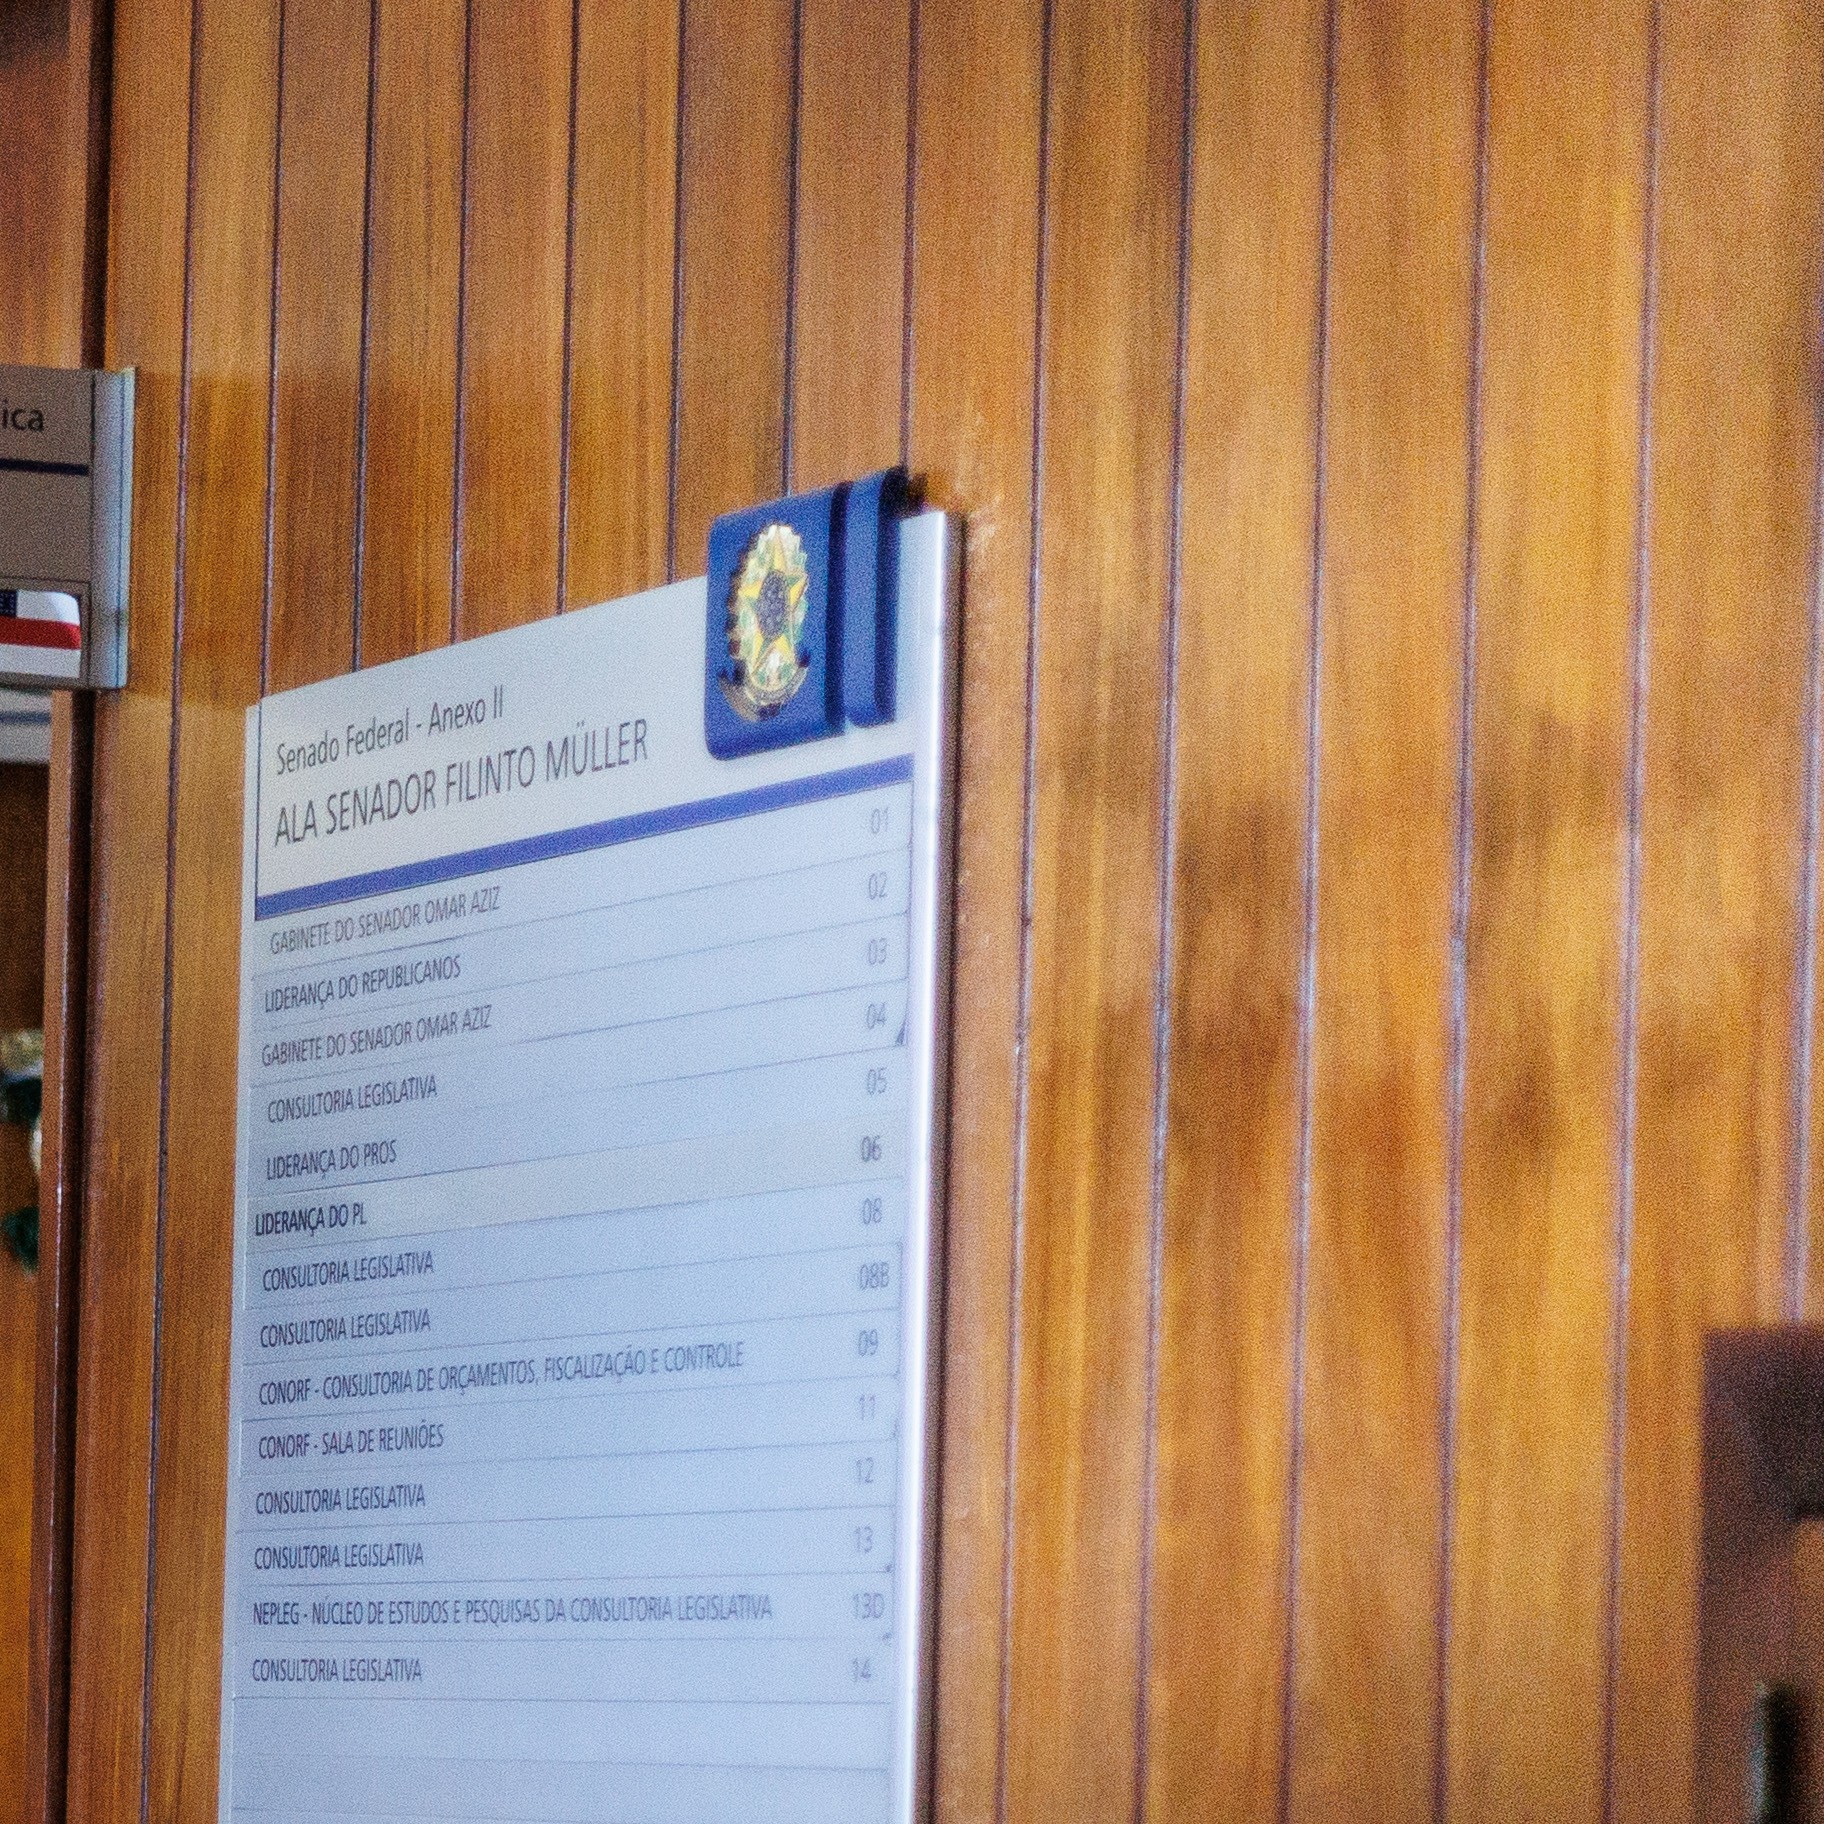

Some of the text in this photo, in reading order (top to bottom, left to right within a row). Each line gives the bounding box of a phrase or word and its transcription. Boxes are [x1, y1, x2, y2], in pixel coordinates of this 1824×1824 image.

[276, 728, 340, 776] Senado
[345, 707, 409, 758] Federal
[429, 694, 488, 735] Anexo
[493, 685, 504, 721] II
[274, 718, 649, 848] ALA SENADOR FILINTO MÜLLER
[270, 886, 501, 955] GABINETE DO SENADOR OMAR AZIZ
[264, 955, 461, 1013] LIDERANÇA DO REPUBLICANOS
[261, 1004, 492, 1066] GABINETE DO SENADOR OMAR AZIZ
[268, 1074, 437, 1123] CONSULTORIA LEGISLATIVA
[266, 1139, 396, 1180] LIDERANÇA DO PROS
[255, 1202, 366, 1236] LIDERANÇA DO PL
[263, 1250, 434, 1291] CONSULTORIA LEGISLATIVA
[260, 1308, 431, 1348] CONSULTORIA LEGISLATIVA
[259, 1377, 310, 1405] CONORF
[323, 1368, 412, 1399] CONSULTORIA
[417, 1367, 434, 1391] DE
[439, 1359, 539, 1395] ORÇAMENTOS,
[544, 1345, 646, 1383] FISCALIZAÇÃO
[652, 1349, 658, 1374] E
[664, 1341, 744, 1372] CONTROLE
[259, 1432, 310, 1459] CONORF
[322, 1429, 354, 1455] SALA
[358, 1427, 374, 1451] DE
[379, 1419, 444, 1450] REUNIÕES
[256, 1484, 425, 1514] CONSULTORIA LEGISLATIVA
[254, 1542, 424, 1569] CONSULTORIA LEGISLATIVA
[253, 1601, 299, 1625] NEPLEG
[312, 1595, 362, 1624] NÚCLEO
[367, 1600, 384, 1624] DE
[389, 1600, 449, 1624] ESTUDOS
[454, 1600, 460, 1623] E
[466, 1599, 540, 1627] PESQUISAS
[545, 1598, 566, 1622] DA
[570, 1596, 672, 1622] CONSULTORIA
[678, 1594, 773, 1619] LEGISLATIVA
[252, 1658, 422, 1681] CONSULTORIA LEGISLATIVA
